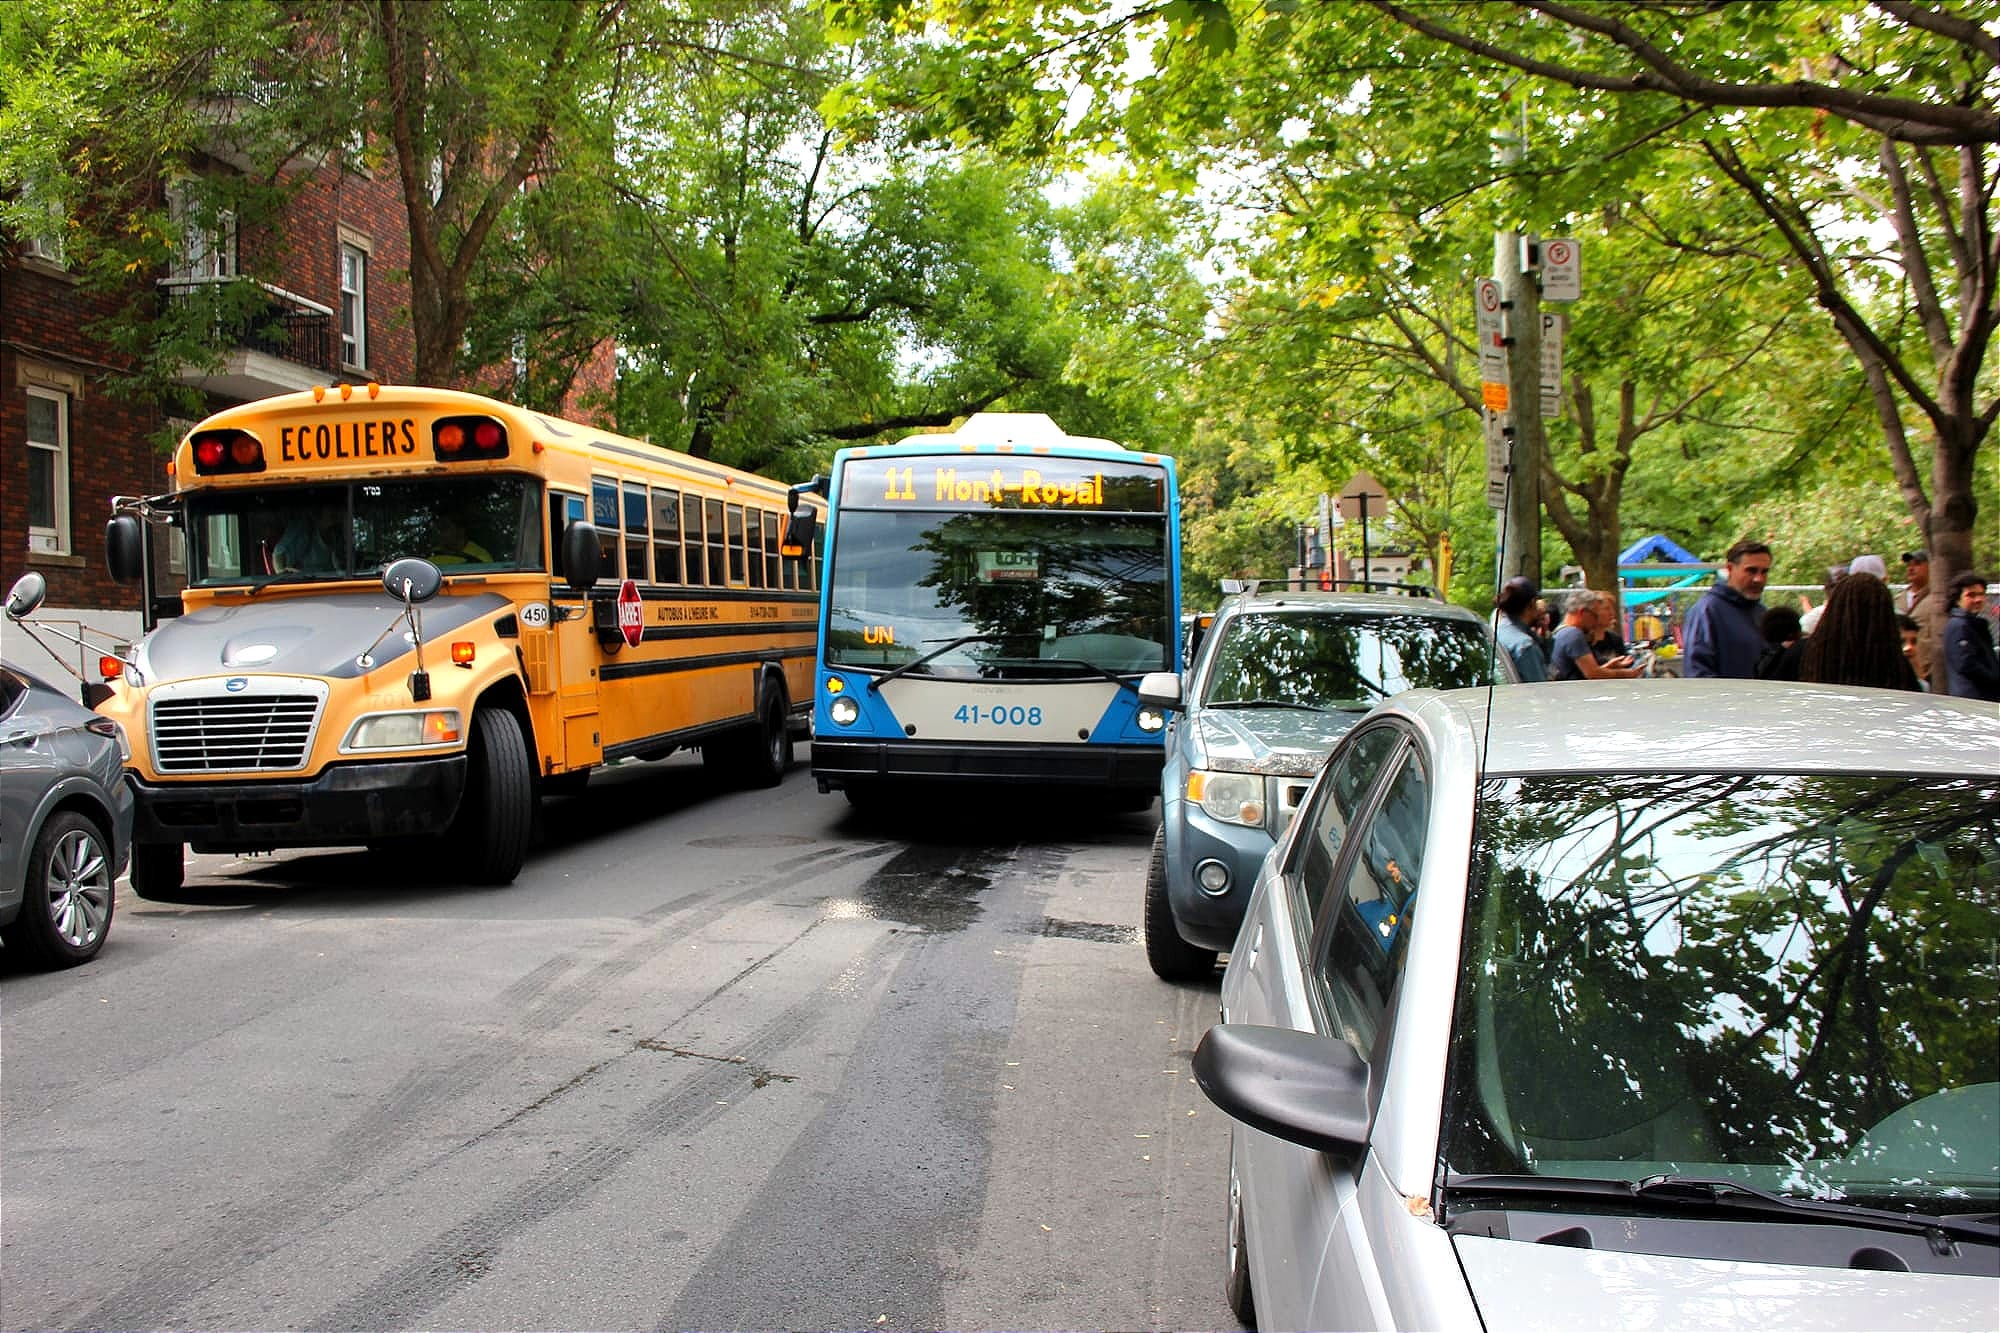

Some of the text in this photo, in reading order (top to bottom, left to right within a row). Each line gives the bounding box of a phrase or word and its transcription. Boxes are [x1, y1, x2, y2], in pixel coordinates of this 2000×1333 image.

[1543, 315, 1553, 336] P
[281, 418, 415, 462] ECOLIERS
[884, 466, 1104, 504] 11 Mont-Royal
[524, 608, 547, 622] 450
[657, 607, 682, 621] AUTOBUS
[864, 625, 894, 645] UN
[953, 704, 1042, 726] 41-008
